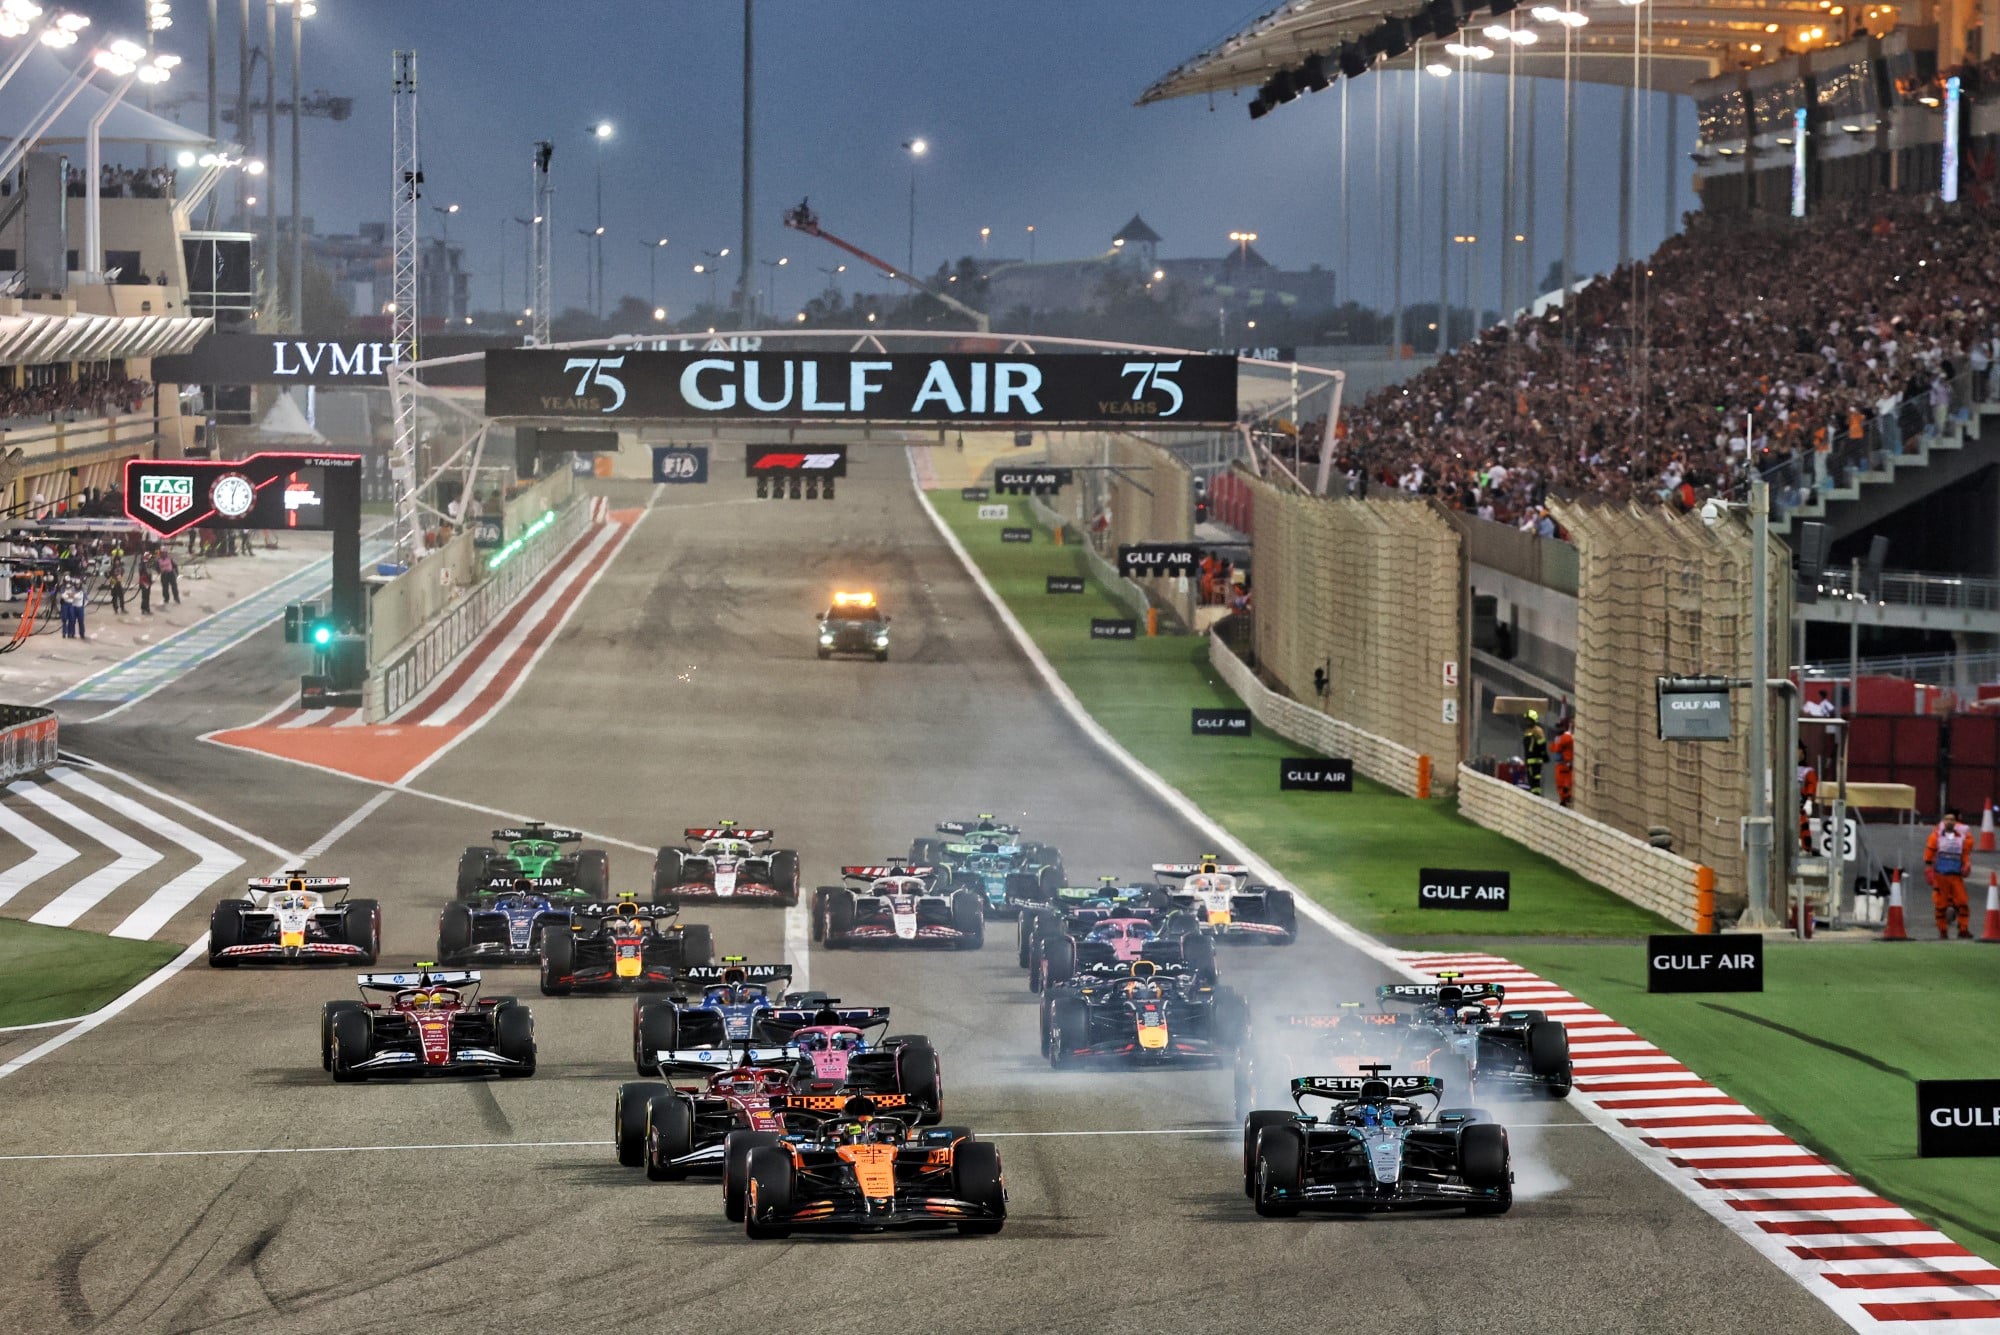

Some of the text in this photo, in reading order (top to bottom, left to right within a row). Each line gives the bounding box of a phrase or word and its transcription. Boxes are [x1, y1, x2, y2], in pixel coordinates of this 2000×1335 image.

[273, 342, 402, 376] LVMH
[563, 355, 626, 413] 75
[679, 358, 1044, 414] GULF AIR
[1121, 359, 1183, 417] 75
[540, 397, 599, 411] YEARS
[1099, 402, 1157, 415] YEARS
[1002, 474, 1056, 484] GULF AIR
[145, 479, 188, 493] TAG
[143, 495, 190, 517] HEUER
[1127, 553, 1191, 564] GULF AIR
[1672, 701, 1720, 709] GULF AIR
[1197, 719, 1224, 728] GULF
[1288, 771, 1345, 782] GULF AIR
[490, 878, 562, 887] ATLSIAN
[1423, 885, 1505, 899] GULF AIR
[1654, 954, 1755, 970] GULF AIR
[689, 966, 775, 977] ATLAIAN
[1395, 984, 1484, 995] PETRAS
[1314, 1078, 1418, 1088] PETRAS
